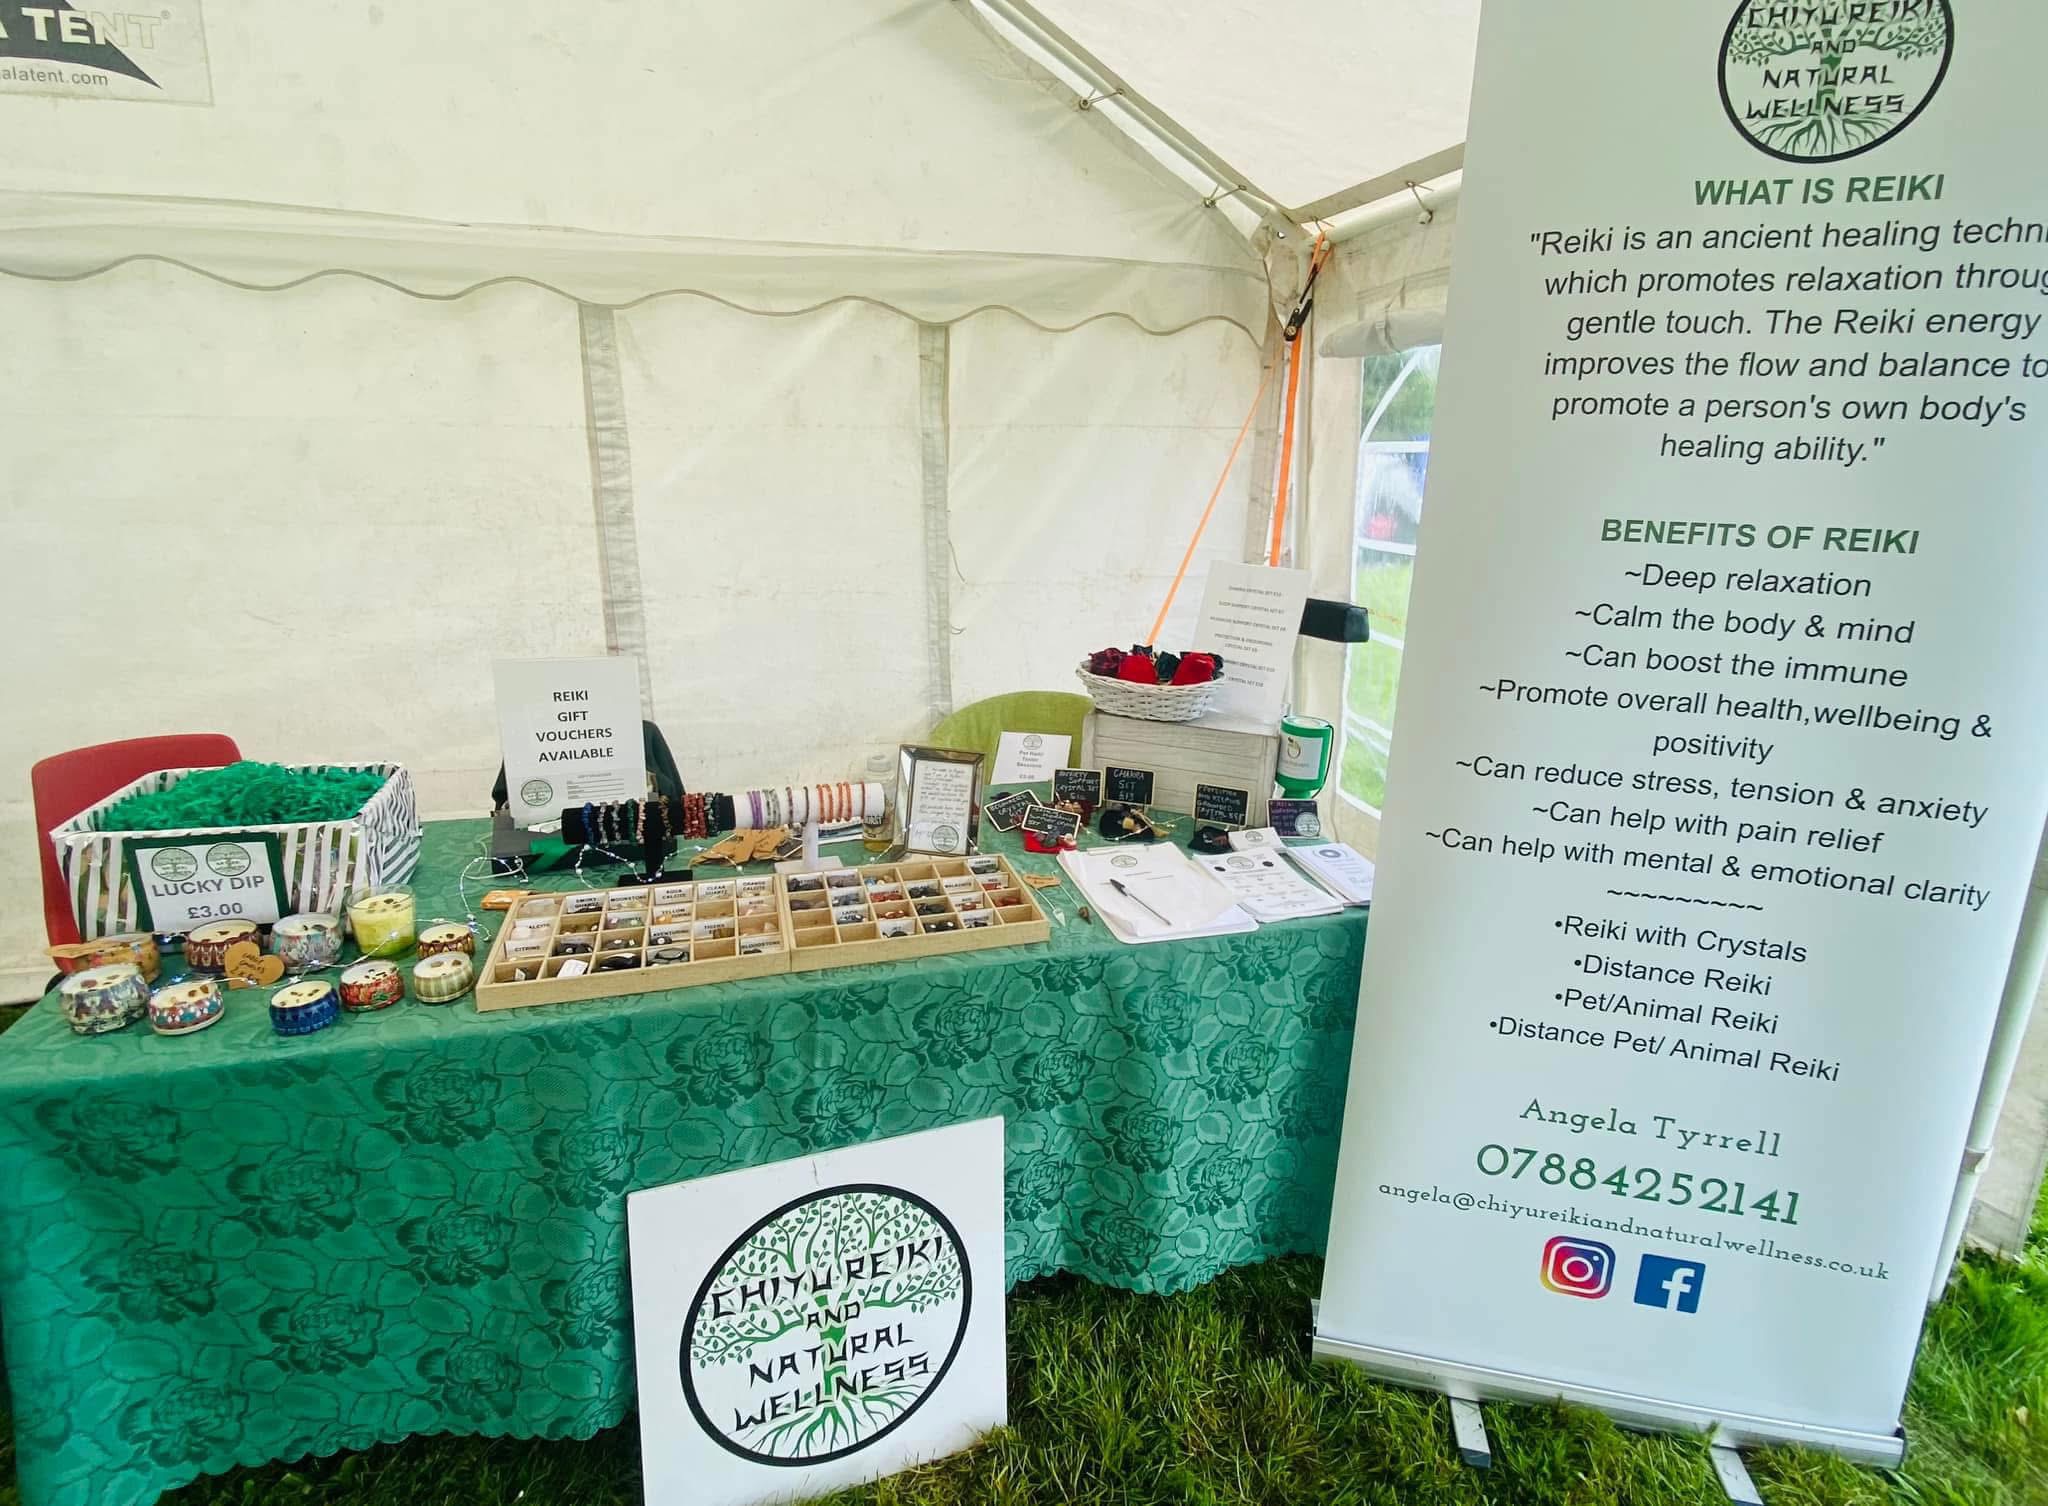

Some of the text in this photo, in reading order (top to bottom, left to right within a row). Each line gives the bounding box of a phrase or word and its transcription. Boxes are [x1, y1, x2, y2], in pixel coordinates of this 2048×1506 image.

[1749, 0, 1932, 27] CHIYU REIKI
[1811, 39, 1856, 54] AND
[0, 67, 108, 86] alatent.com
[1763, 65, 1894, 88] NATURAL
[1746, 94, 1905, 119] WELLNESS
[1695, 174, 1944, 205] WHAT IS REIKI
[1531, 227, 1613, 256] "Reiki
[1623, 226, 1646, 250] is
[1657, 230, 1692, 249] an
[1703, 224, 1813, 249] ancient
[1822, 220, 1940, 252] healing
[1545, 268, 1627, 295] which
[1637, 268, 1775, 298] promotes
[1786, 265, 1942, 291] relaxation
[1567, 308, 2042, 341] gentle touch. The Reiki energy
[1545, 352, 2048, 381] improves the flow and balance to
[1552, 393, 2026, 427] promote a person's own body's
[1661, 433, 1885, 467] healing ability."
[1601, 519, 1919, 554] BENEFITS OF REIKI
[1726, 569, 1871, 597] relaxation
[1672, 608, 1714, 631] the
[1724, 610, 1796, 641] body
[1804, 615, 1824, 637] &
[1837, 618, 1915, 643] mind
[1646, 648, 1723, 673] boost
[1731, 653, 1774, 677] the
[1785, 656, 1908, 687] immune
[553, 690, 588, 702] REIKI
[557, 711, 588, 722] GIFT
[1618, 692, 1707, 714] overall
[1971, 714, 1992, 738] &
[536, 727, 612, 742] VOUCHERS
[1653, 734, 1774, 765] positivity
[538, 747, 614, 763] AVAILABLE
[1535, 764, 1623, 787] reduce
[1632, 771, 1718, 799] stress,
[1731, 778, 1834, 807] tension
[1845, 788, 1865, 810] &
[1877, 797, 1988, 828] anxiety
[1610, 806, 1665, 835] help
[1675, 814, 1727, 836] with
[1736, 821, 1796, 843] pain
[1807, 828, 1885, 853] relief
[152, 875, 265, 897] LUCKY DIP
[1502, 835, 1555, 863] help
[1564, 842, 1614, 864] with
[1624, 851, 1713, 874] mental
[1722, 856, 1740, 877] &
[1751, 864, 1895, 896] emotional
[1904, 880, 1990, 911] clarity
[188, 902, 243, 919] £3.00
[1636, 925, 1686, 948] with
[1697, 930, 1807, 962] Crystals
[1704, 969, 1772, 995] Reiki
[1711, 1007, 1778, 1034] Reiki
[1669, 1039, 1761, 1068] Animal
[1770, 1052, 1840, 1081] Reiki
[1520, 1098, 1780, 1157] Angela Tyrrell
[1477, 1144, 1799, 1228] 07884252141
[1379, 1185, 1888, 1280] angela@chiyureikiandnaturalwellness.co.uk
[712, 1236, 942, 1321] CHIYU REIKI
[806, 1301, 861, 1332] AND
[749, 1322, 915, 1389] NATURAL
[734, 1351, 929, 1432] WELLNESS
